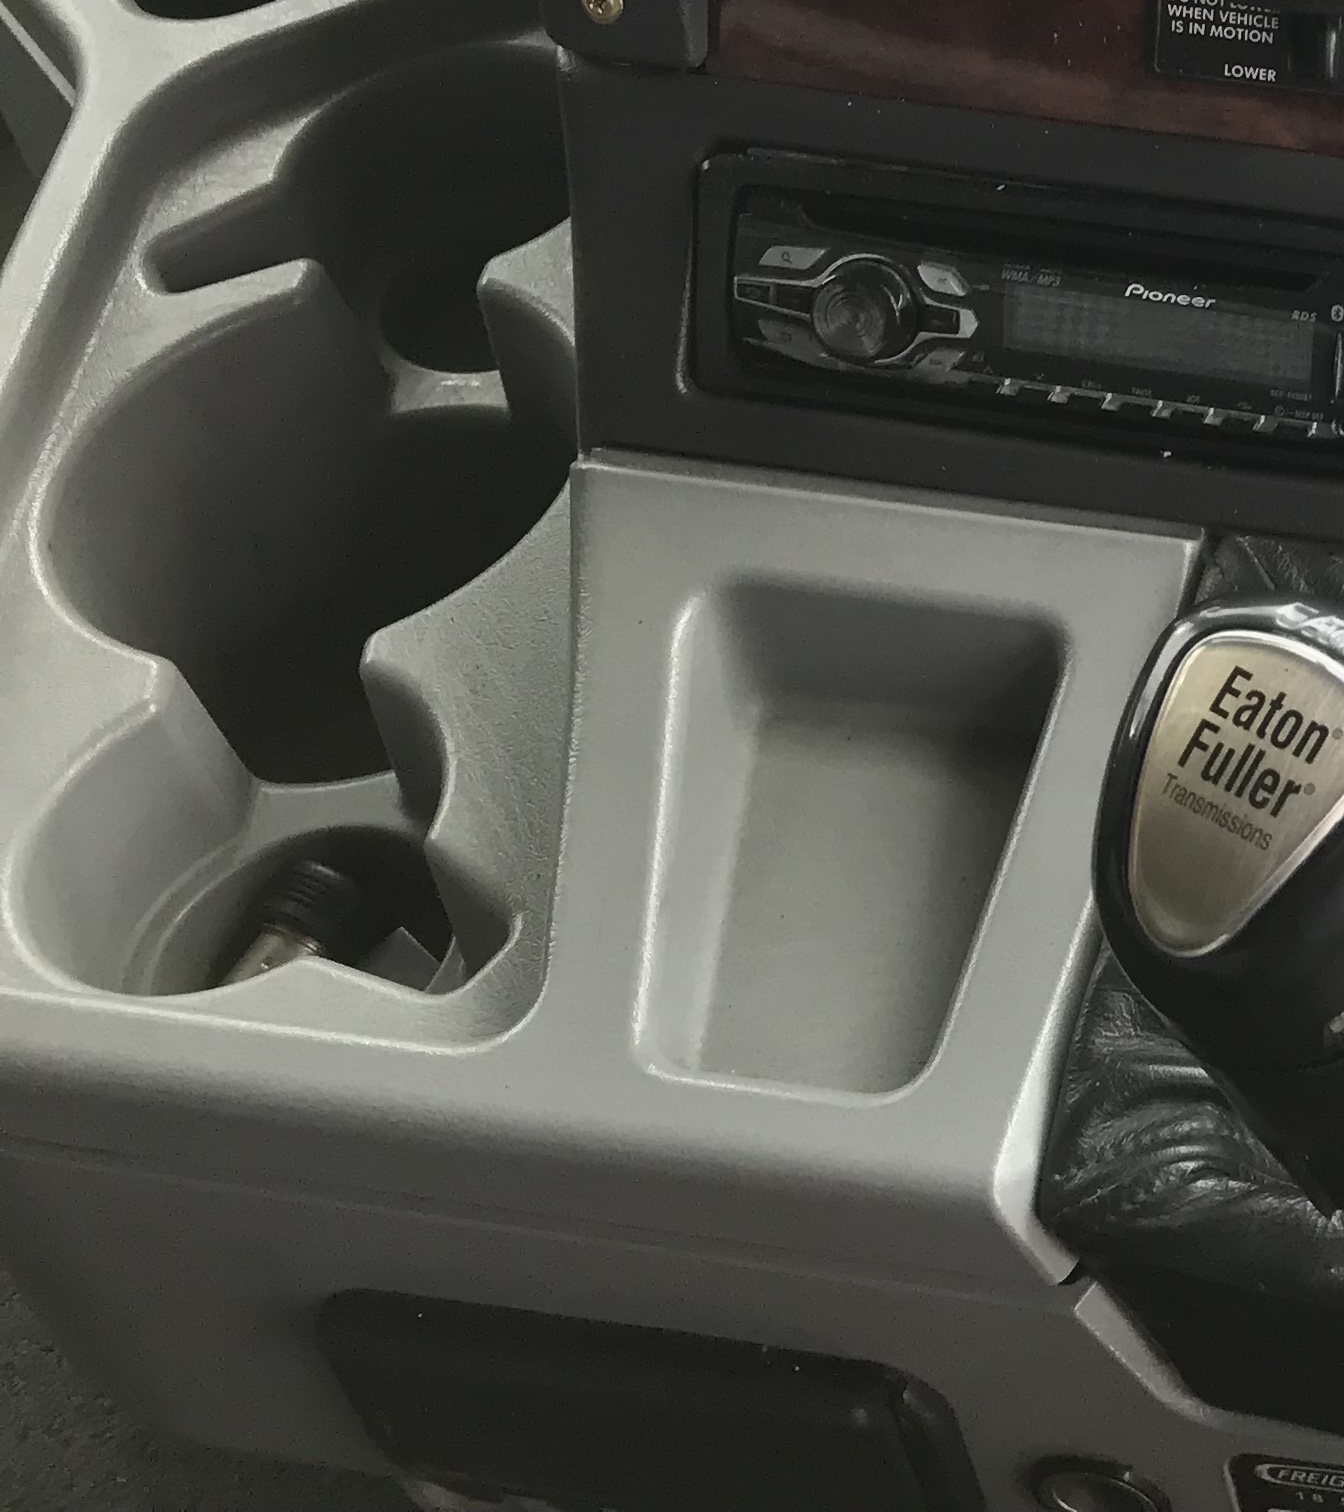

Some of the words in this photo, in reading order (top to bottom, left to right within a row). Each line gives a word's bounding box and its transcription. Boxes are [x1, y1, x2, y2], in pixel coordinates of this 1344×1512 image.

[1167, 4, 1214, 22] WHEN
[1219, 10, 1280, 30] VEHICLE
[1171, 19, 1184, 34] IS
[1189, 21, 1205, 36] IN
[1209, 25, 1274, 44] MOTION
[1224, 64, 1276, 82] LOWER
[1124, 283, 1217, 309] Pioneer
[1209, 665, 1330, 765] Eaton
[1176, 718, 1303, 820] Fuller
[1161, 773, 1274, 852] Transmissions
